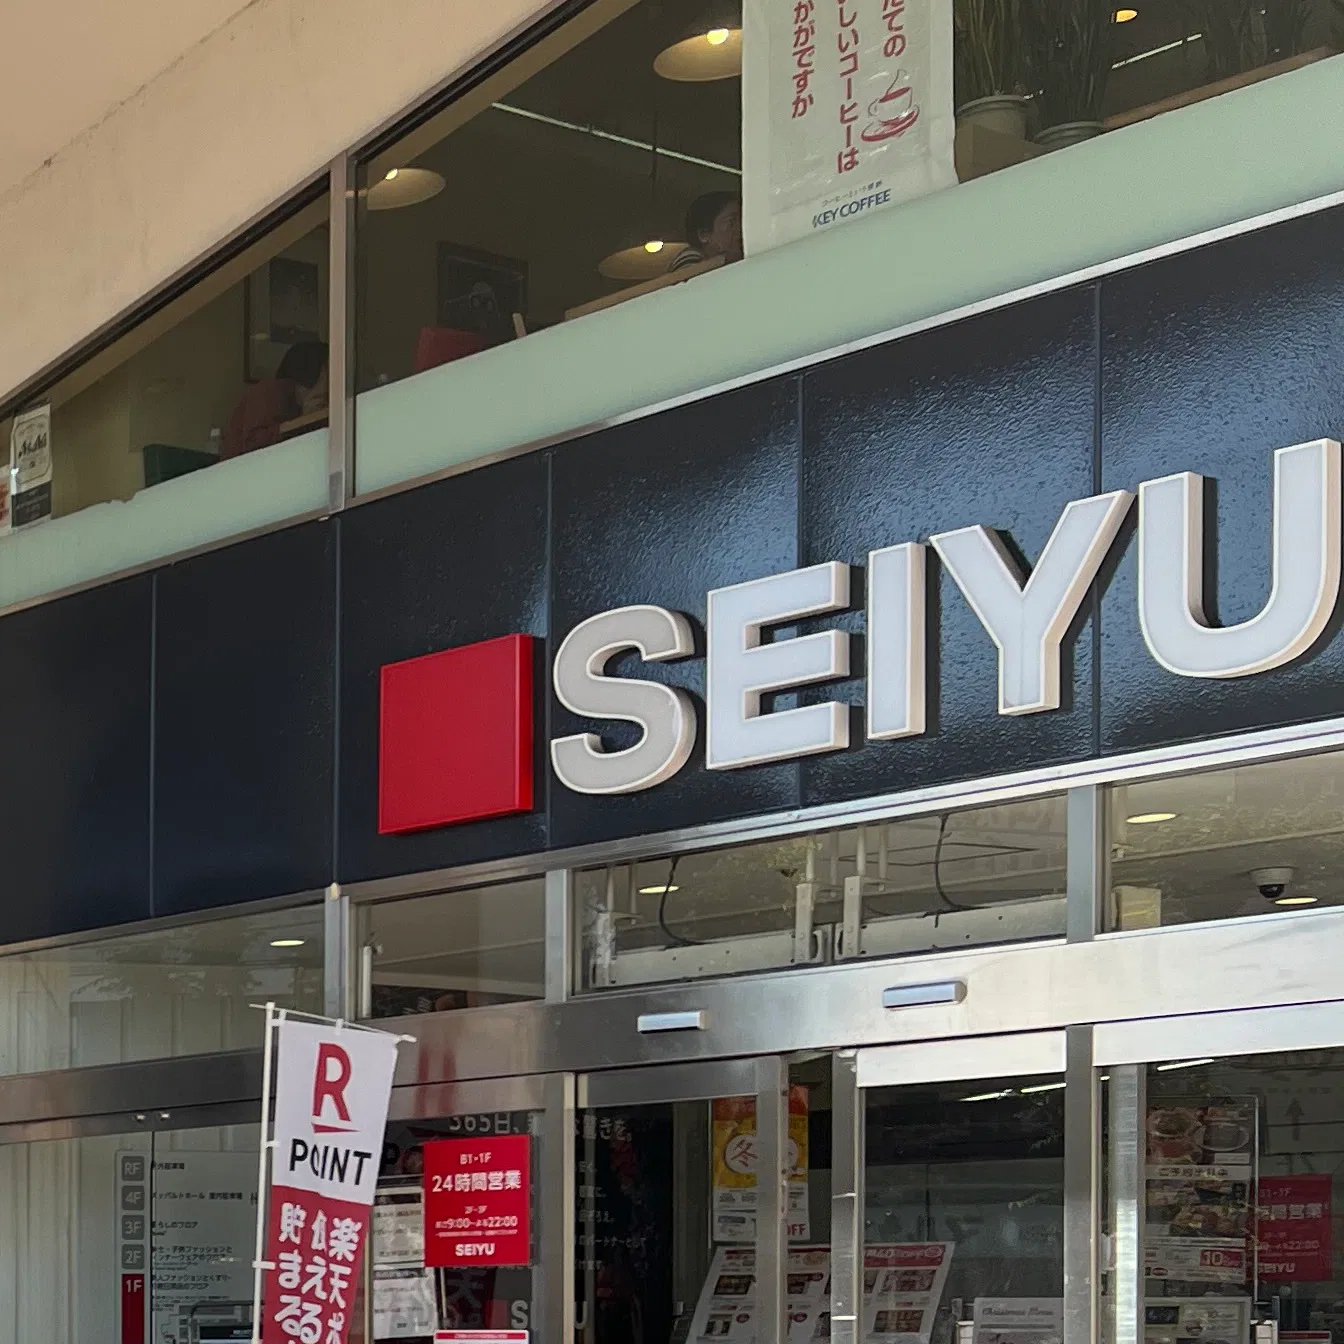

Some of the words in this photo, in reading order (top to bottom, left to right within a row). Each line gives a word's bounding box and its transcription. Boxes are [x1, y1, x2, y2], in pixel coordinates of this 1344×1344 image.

[837, 0, 860, 174] しいコーヒーは
[812, 207, 839, 228] KEY
[840, 188, 892, 217] COFFEE
[550, 437, 1343, 796] SEIYU
[124, 1162, 141, 1175] RF
[432, 1169, 522, 1192] 24時間営業
[124, 1221, 142, 1235] 3F
[124, 1250, 141, 1264] 2F
[455, 1243, 496, 1257] SEIYU
[126, 1279, 143, 1293] 1F
